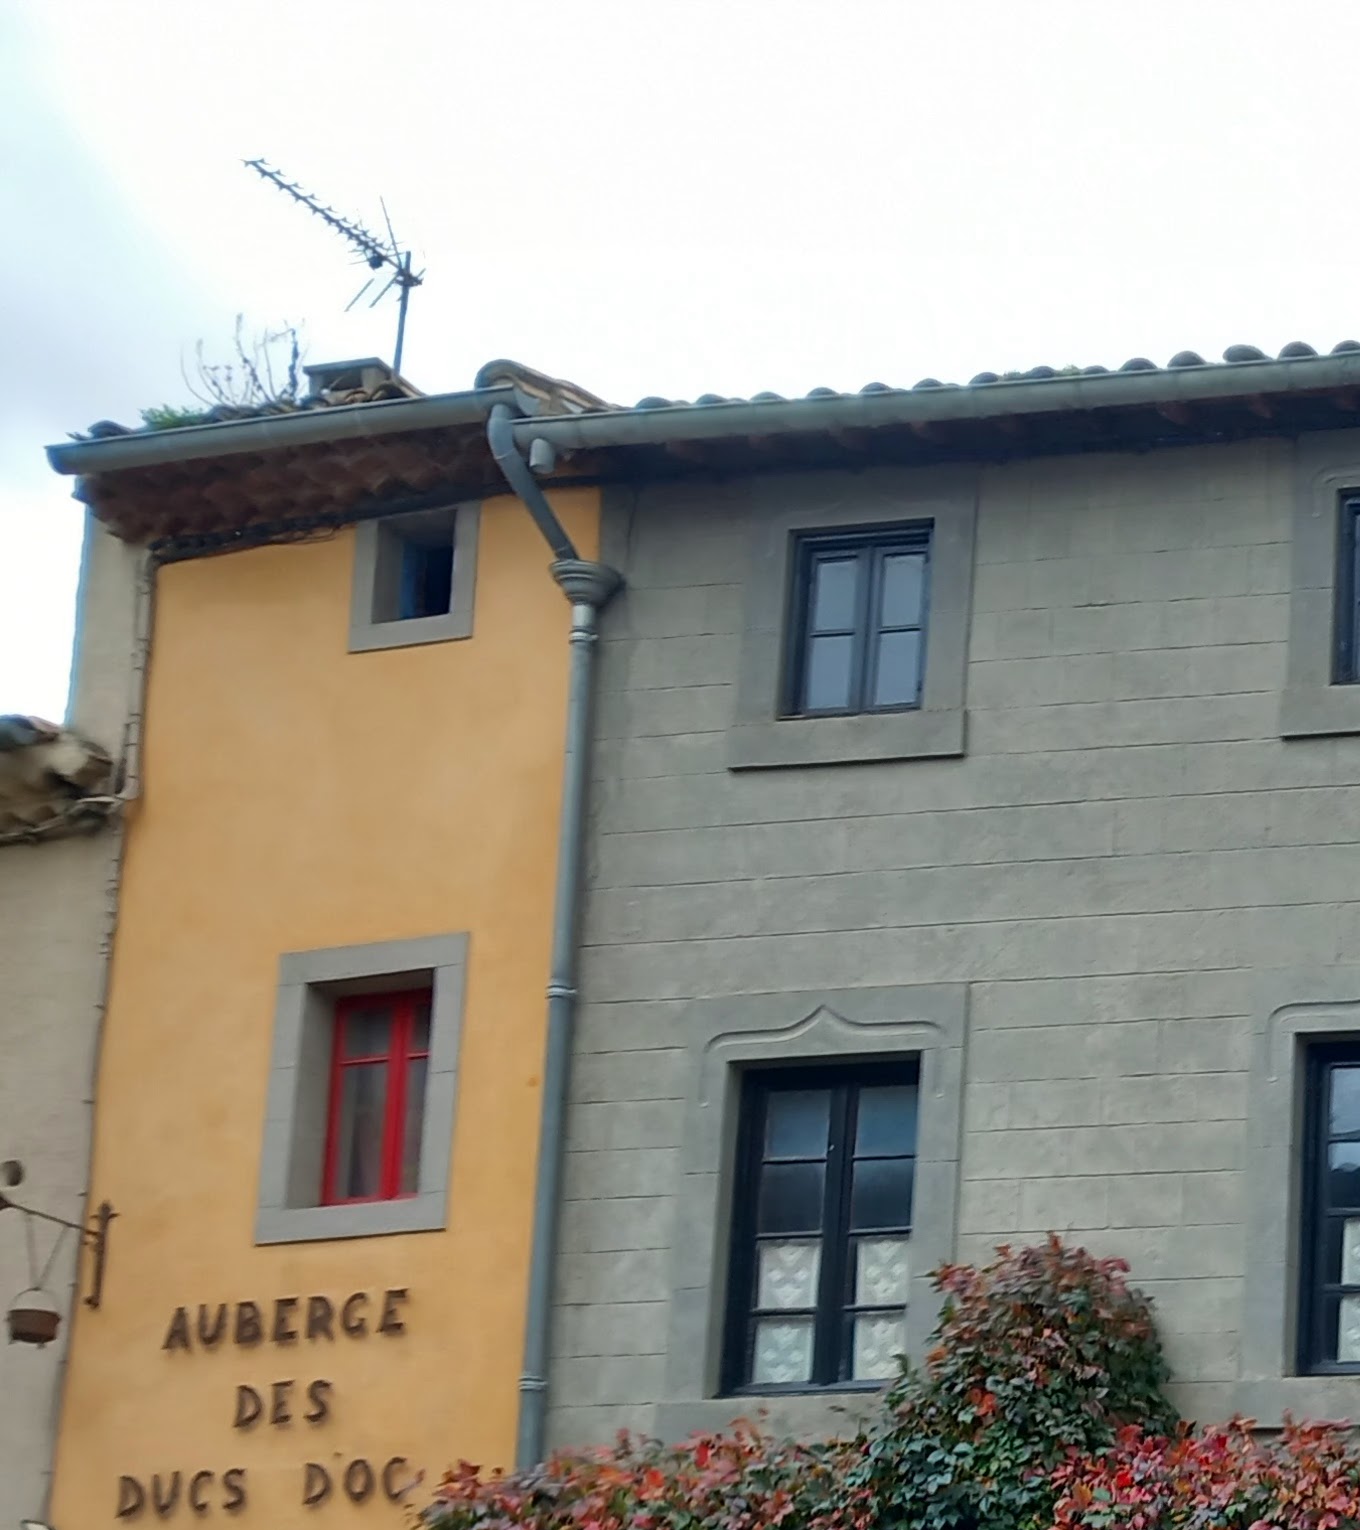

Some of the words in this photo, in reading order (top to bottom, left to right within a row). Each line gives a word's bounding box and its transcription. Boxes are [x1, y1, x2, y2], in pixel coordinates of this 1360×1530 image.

[161, 1288, 409, 1350] AUBERGE
[233, 1379, 333, 1428] DES
[115, 1468, 246, 1519] DUCS
[302, 1451, 410, 1505] D'OC
